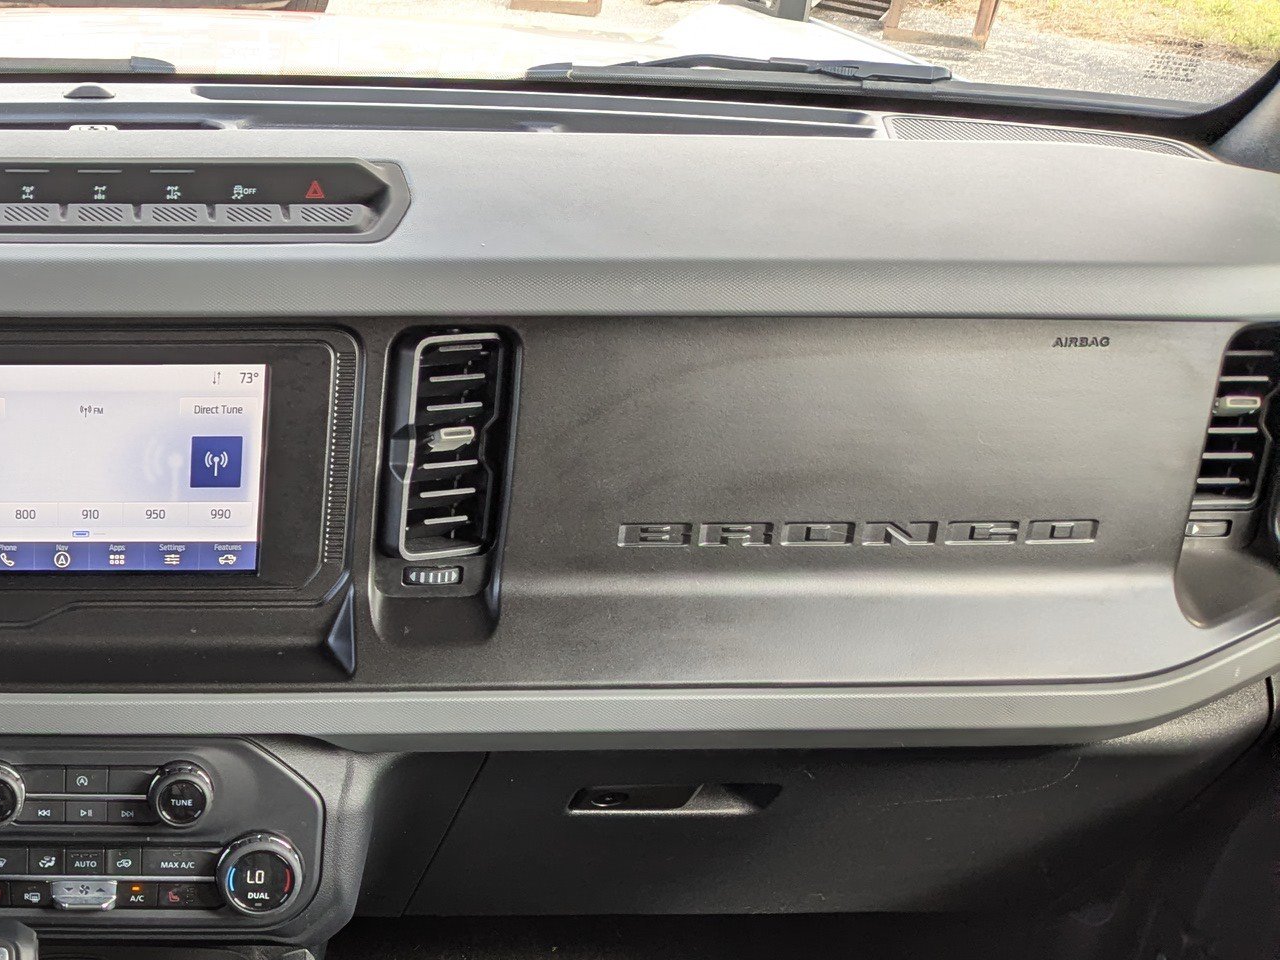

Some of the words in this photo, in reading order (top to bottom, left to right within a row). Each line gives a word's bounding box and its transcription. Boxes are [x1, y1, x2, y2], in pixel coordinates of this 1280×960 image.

[243, 187, 257, 195] OFF
[1052, 336, 1111, 348] AIRBAG
[239, 372, 260, 385] 73°
[93, 407, 104, 415] FM
[194, 405, 219, 415] Direct
[221, 405, 244, 415] Tune
[15, 509, 36, 520] 800
[81, 509, 100, 520] 910
[145, 509, 166, 520] 950
[210, 509, 231, 520] 990
[617, 520, 1099, 547] BRONCO
[109, 544, 126, 552] Apps
[159, 544, 186, 552] Settings
[74, 860, 97, 868] AUTO
[180, 861, 195, 869] A/C
[130, 894, 144, 902] A/C
